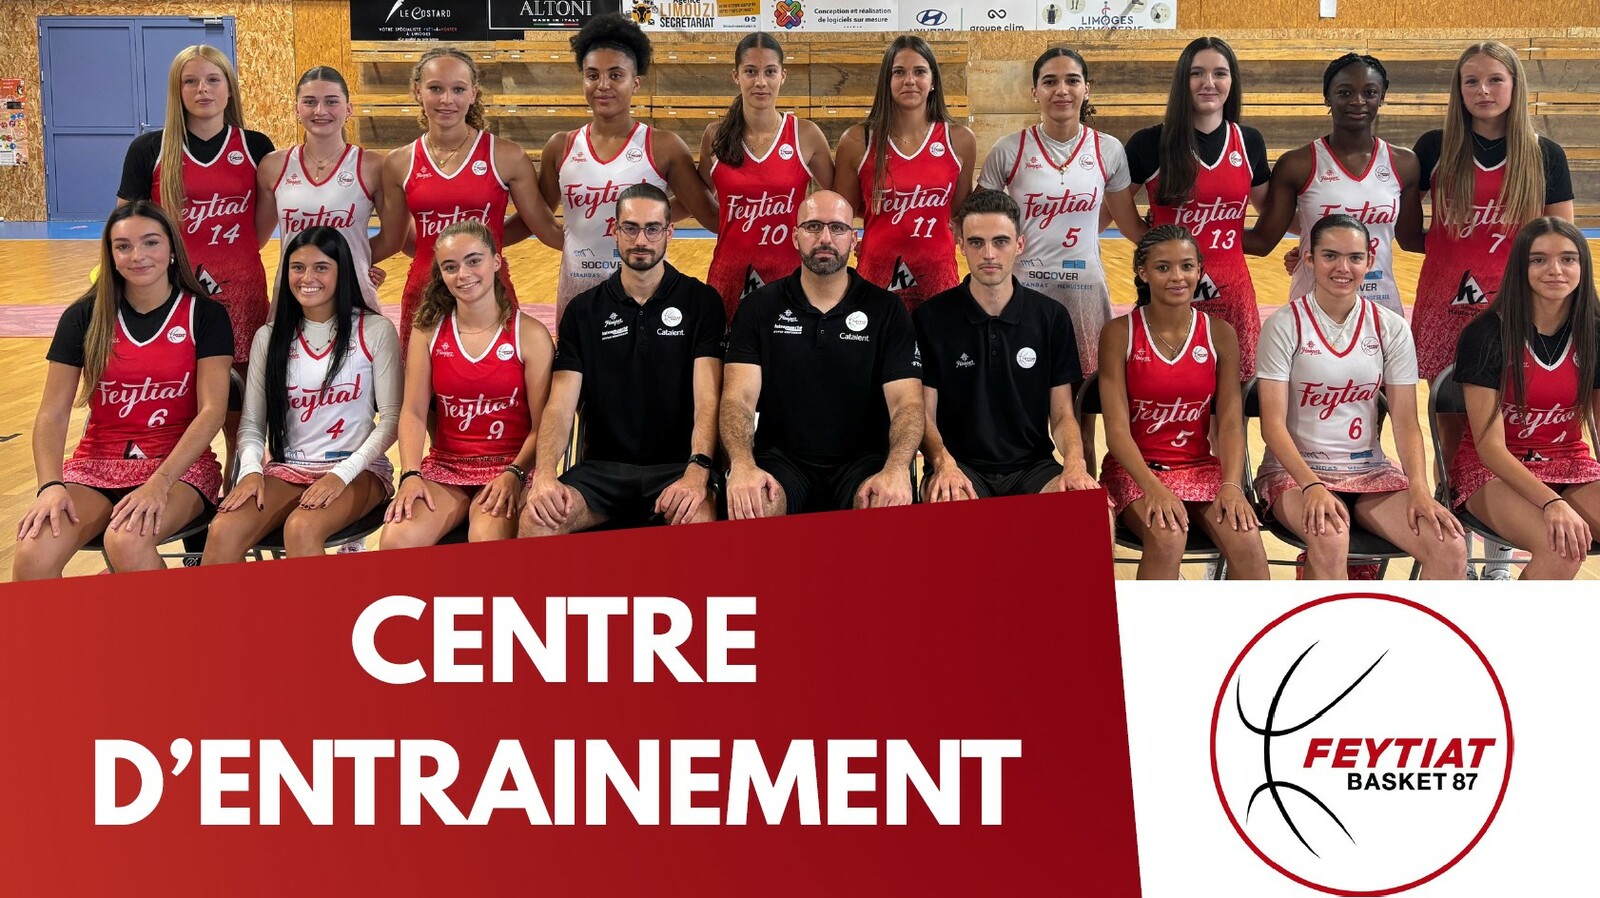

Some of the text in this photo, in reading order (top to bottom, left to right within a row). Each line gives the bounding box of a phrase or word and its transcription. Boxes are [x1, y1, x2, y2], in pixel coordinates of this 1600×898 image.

[400, 9, 409, 17] LE
[520, 0, 592, 16] ALTONI
[660, 3, 715, 17] LIMOUZI
[660, 15, 715, 28] SECRÉTARIAT
[1081, 16, 1134, 25] LIMOGES
[208, 224, 241, 246] 14
[603, 216, 617, 237] 1
[758, 224, 788, 246] 10
[910, 216, 937, 238] 11
[1062, 227, 1081, 248] 5
[1209, 228, 1237, 250] 13
[1489, 233, 1506, 253] 7
[1028, 271, 1079, 280] SOCOVER
[656, 328, 685, 336] Catalent
[839, 332, 870, 342] Catalent
[147, 408, 168, 428] 6
[326, 418, 345, 439] 4
[487, 420, 505, 440] 9
[1348, 417, 1363, 440] 6
[1171, 430, 1195, 448] 5
